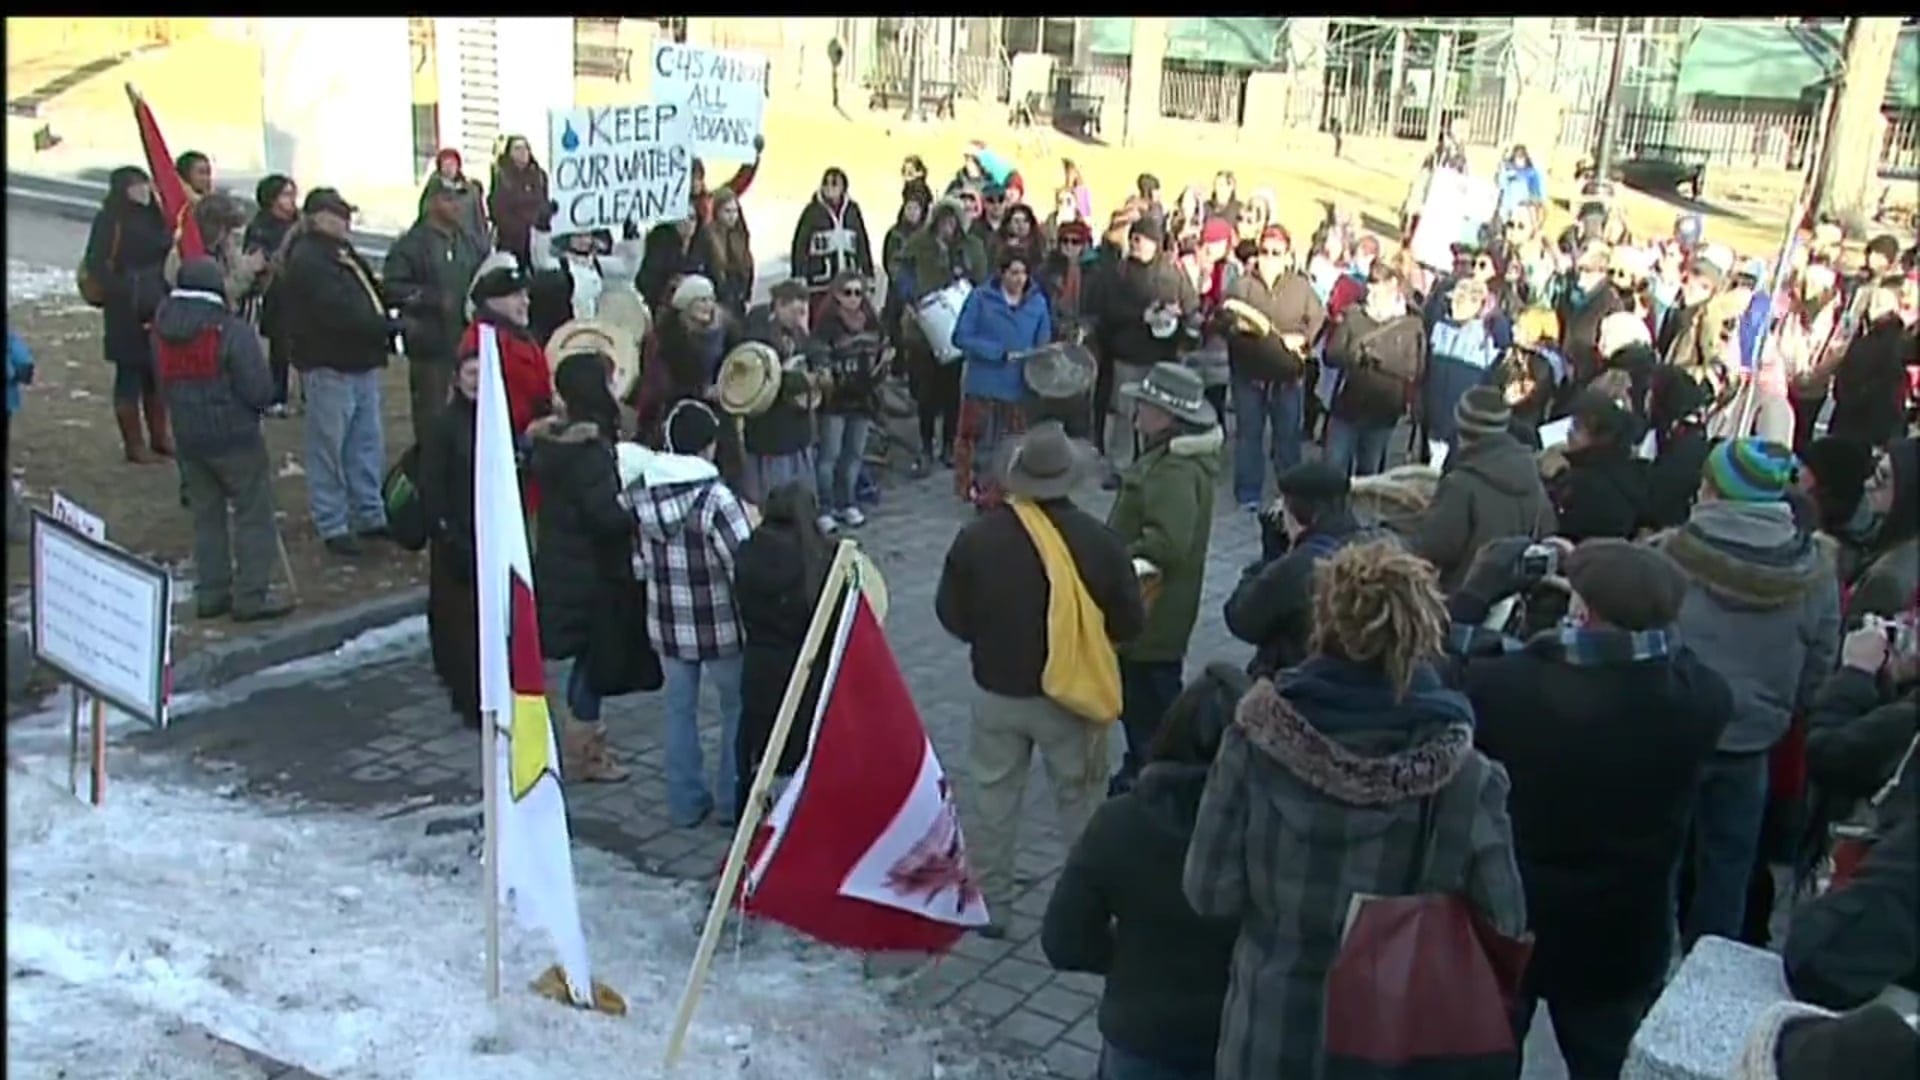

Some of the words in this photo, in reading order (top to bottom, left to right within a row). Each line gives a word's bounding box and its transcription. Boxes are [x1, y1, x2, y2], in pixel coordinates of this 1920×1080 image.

[687, 83, 728, 109] ALL
[588, 104, 678, 147] KEEP
[557, 153, 609, 190] OUR
[615, 145, 687, 182] WATER
[570, 173, 686, 227] CLEAN!
